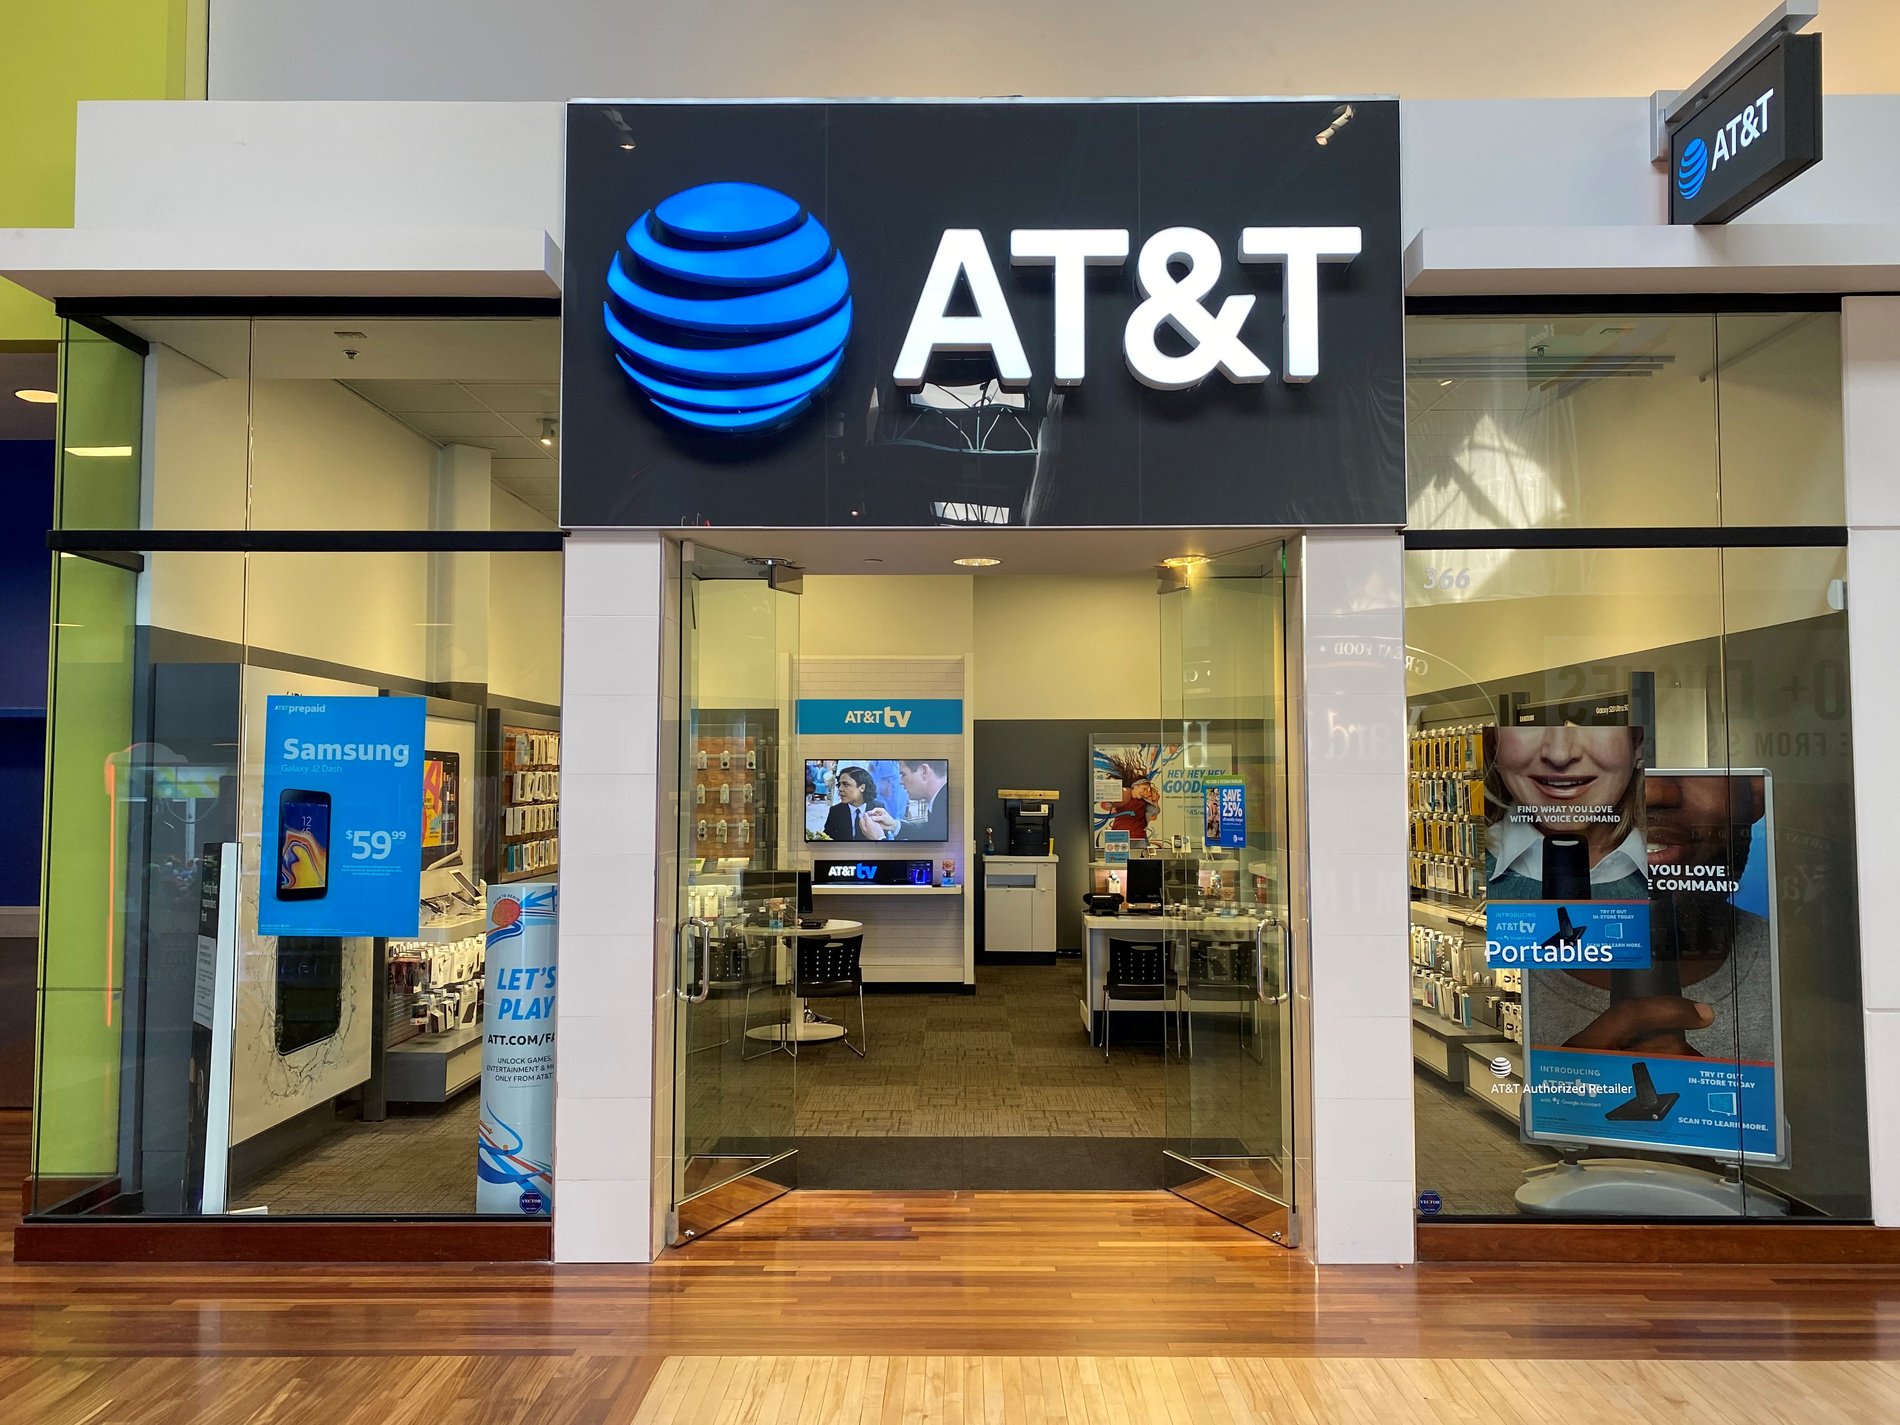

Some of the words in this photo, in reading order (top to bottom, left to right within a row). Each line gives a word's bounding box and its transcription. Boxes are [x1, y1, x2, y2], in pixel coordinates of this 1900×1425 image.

[1711, 87, 1774, 172] AT&T
[892, 225, 1363, 391] AT&T
[1423, 567, 1471, 589] 366
[288, 704, 326, 715] prepaid
[844, 710, 883, 724] AT&T
[884, 706, 912, 728] tv
[282, 737, 410, 768] Samsung
[281, 763, 309, 775] Galaxy
[311, 764, 320, 773] J2
[321, 764, 342, 773] Dash
[1167, 769, 1185, 779] HEY
[1187, 769, 1206, 779] HEY
[1163, 780, 1203, 793] GOOD
[1222, 788, 1242, 802] SAVE
[1222, 801, 1243, 817] 25%
[1517, 805, 1539, 813] FIND
[1540, 805, 1567, 813] WHAT
[1568, 805, 1588, 813] YOU
[1589, 805, 1613, 813] LOVE
[1509, 815, 1534, 823] WITH
[1535, 815, 1542, 823] A
[1544, 815, 1571, 823] VOICE
[1572, 815, 1621, 823] COMMAND
[828, 866, 857, 877] AT&T
[856, 863, 878, 879] tv
[1649, 864, 1682, 877] YOU
[1685, 864, 1725, 877] LOVE
[1656, 878, 1740, 893] COMMAND
[1495, 922, 1519, 931] AT&T
[1519, 920, 1536, 934] tv
[1485, 939, 1613, 963] Portables
[496, 966, 557, 991] LET'S
[497, 995, 556, 1021] PLAY
[497, 1057, 526, 1065] UNLOCK
[486, 1064, 539, 1073] ENTERTAINMENT
[1540, 1065, 1601, 1077] INTRODUCING
[1699, 1070, 1715, 1078] TRY
[1716, 1071, 1725, 1079] IT
[494, 1074, 512, 1082] ONLY
[1688, 1077, 1726, 1087] IN-STORE
[1727, 1080, 1756, 1089] TODAY
[1490, 1083, 1520, 1094] AT&T
[1523, 1083, 1585, 1094] Authorized
[1588, 1083, 1633, 1094] Retailer
[1678, 1116, 1700, 1125] SCAN
[1701, 1118, 1713, 1126] TO
[1742, 1123, 1769, 1132] MORE.
